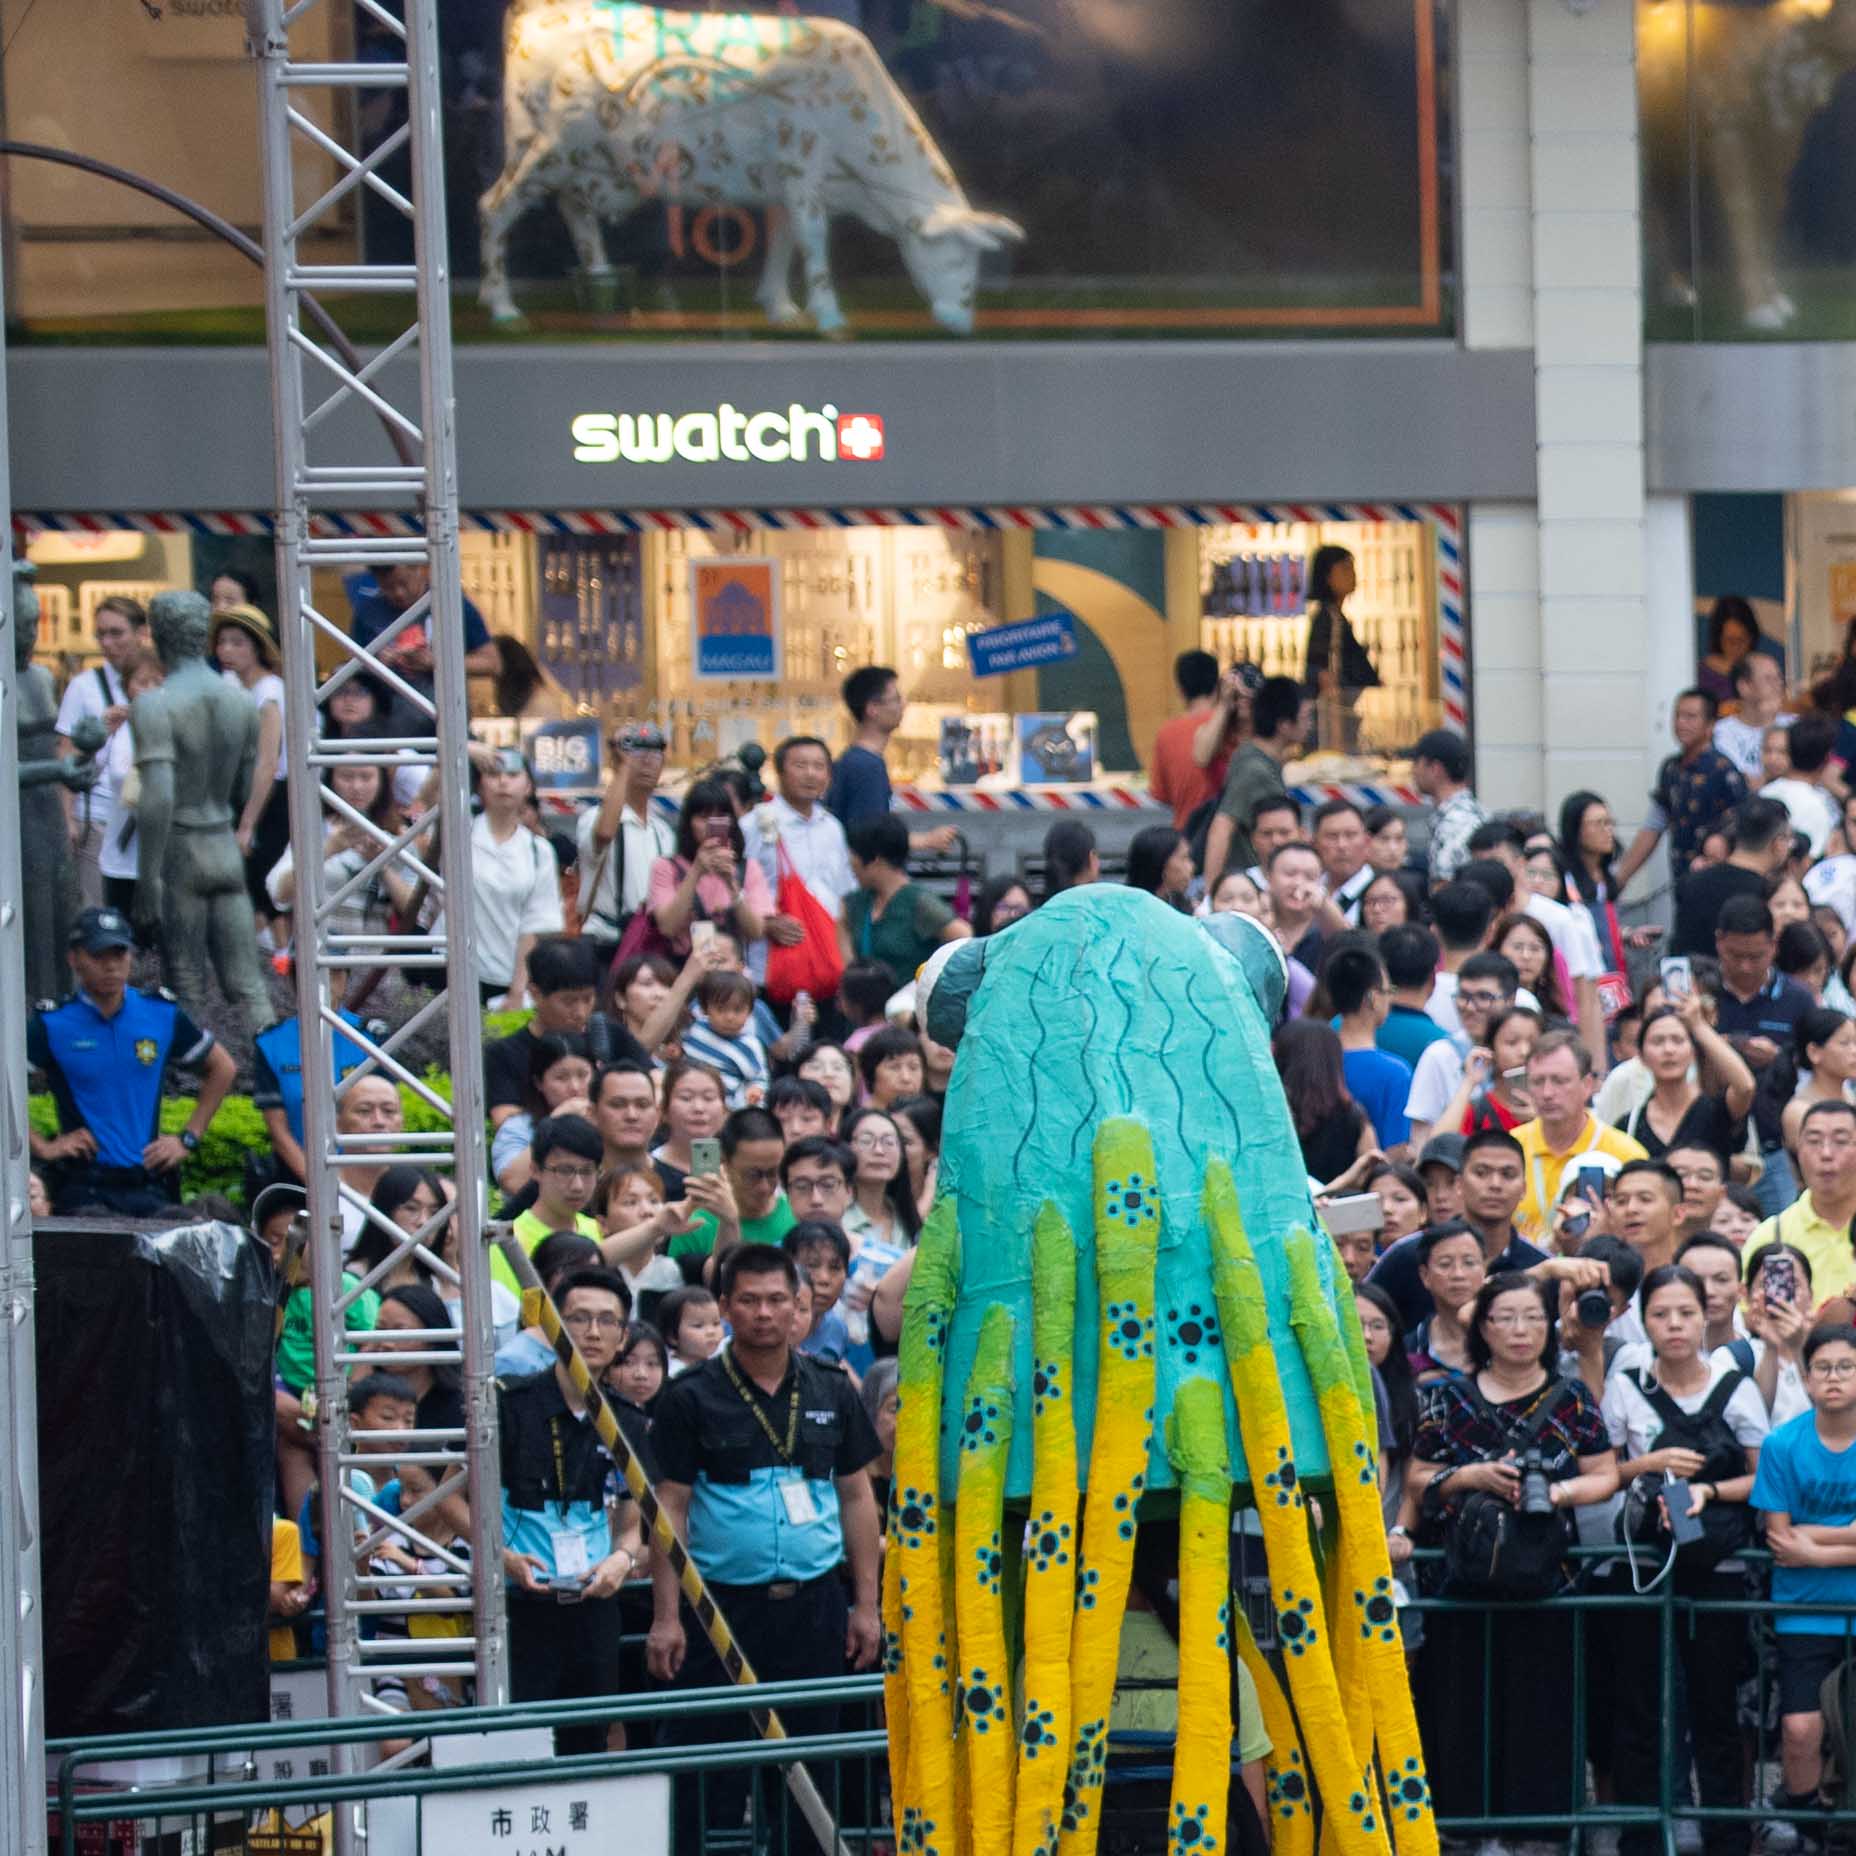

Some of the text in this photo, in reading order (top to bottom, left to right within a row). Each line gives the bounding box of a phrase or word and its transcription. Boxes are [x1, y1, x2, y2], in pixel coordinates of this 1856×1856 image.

[571, 403, 838, 463] swatch
[534, 734, 588, 760] BIG
[491, 1800, 589, 1839] 市政署
